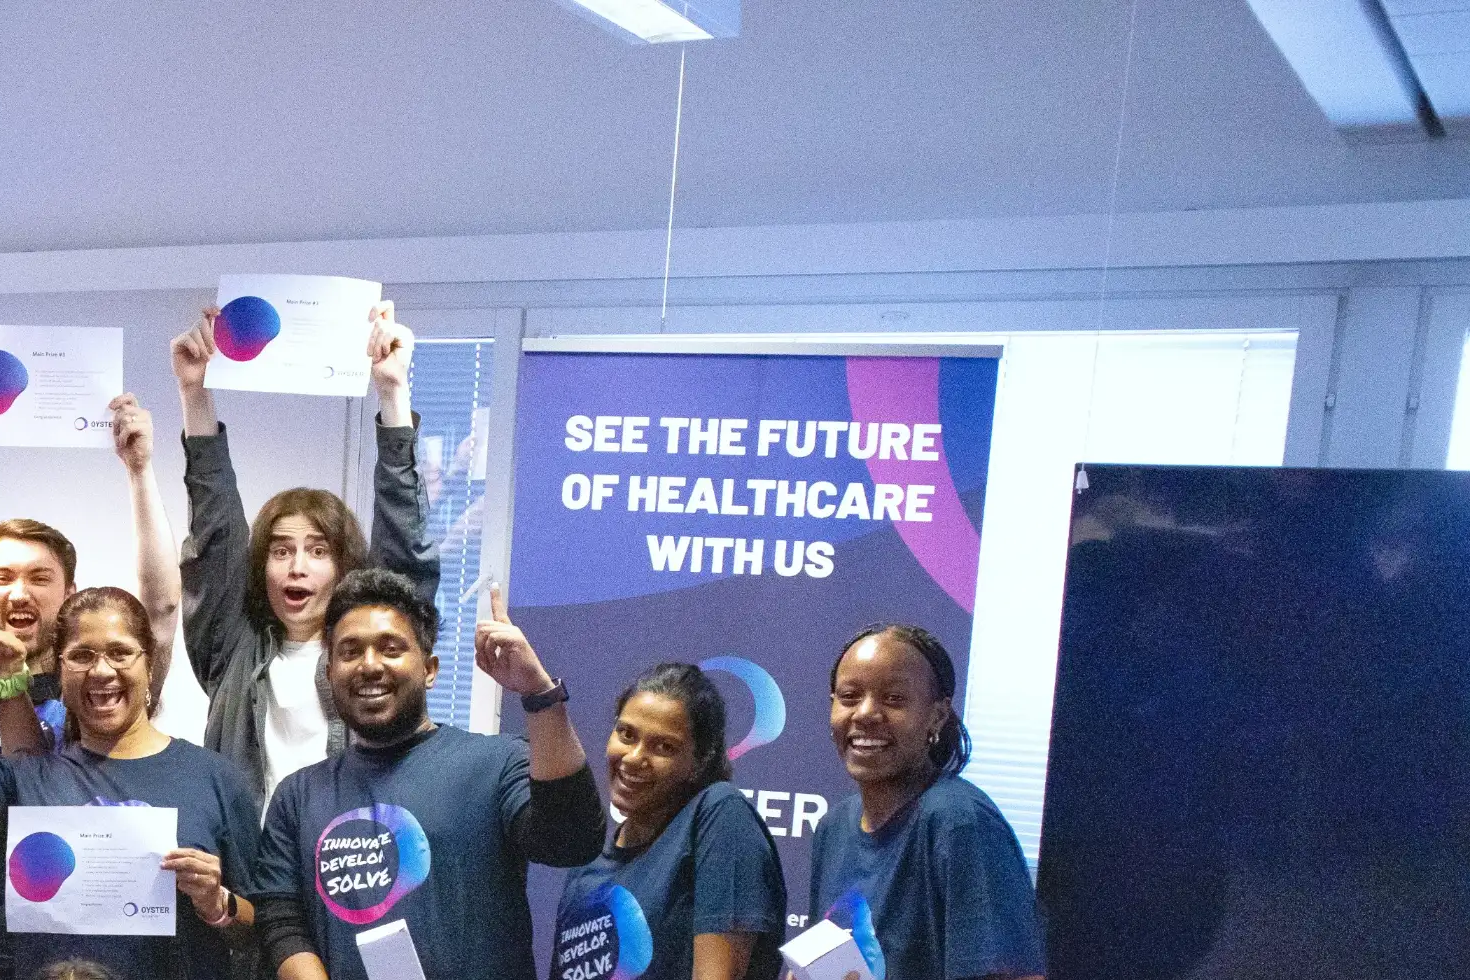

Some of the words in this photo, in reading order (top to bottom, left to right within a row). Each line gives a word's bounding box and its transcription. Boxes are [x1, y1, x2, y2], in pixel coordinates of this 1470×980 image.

[90, 420, 113, 428] OYSTE
[564, 414, 650, 453] SEE
[659, 416, 748, 457] THE
[756, 418, 942, 462] FUTURE
[561, 473, 620, 511] OF
[627, 475, 936, 522] HEALTHCARE
[646, 534, 765, 577] WITH
[773, 540, 835, 579] US
[141, 906, 170, 915] OYSTER
